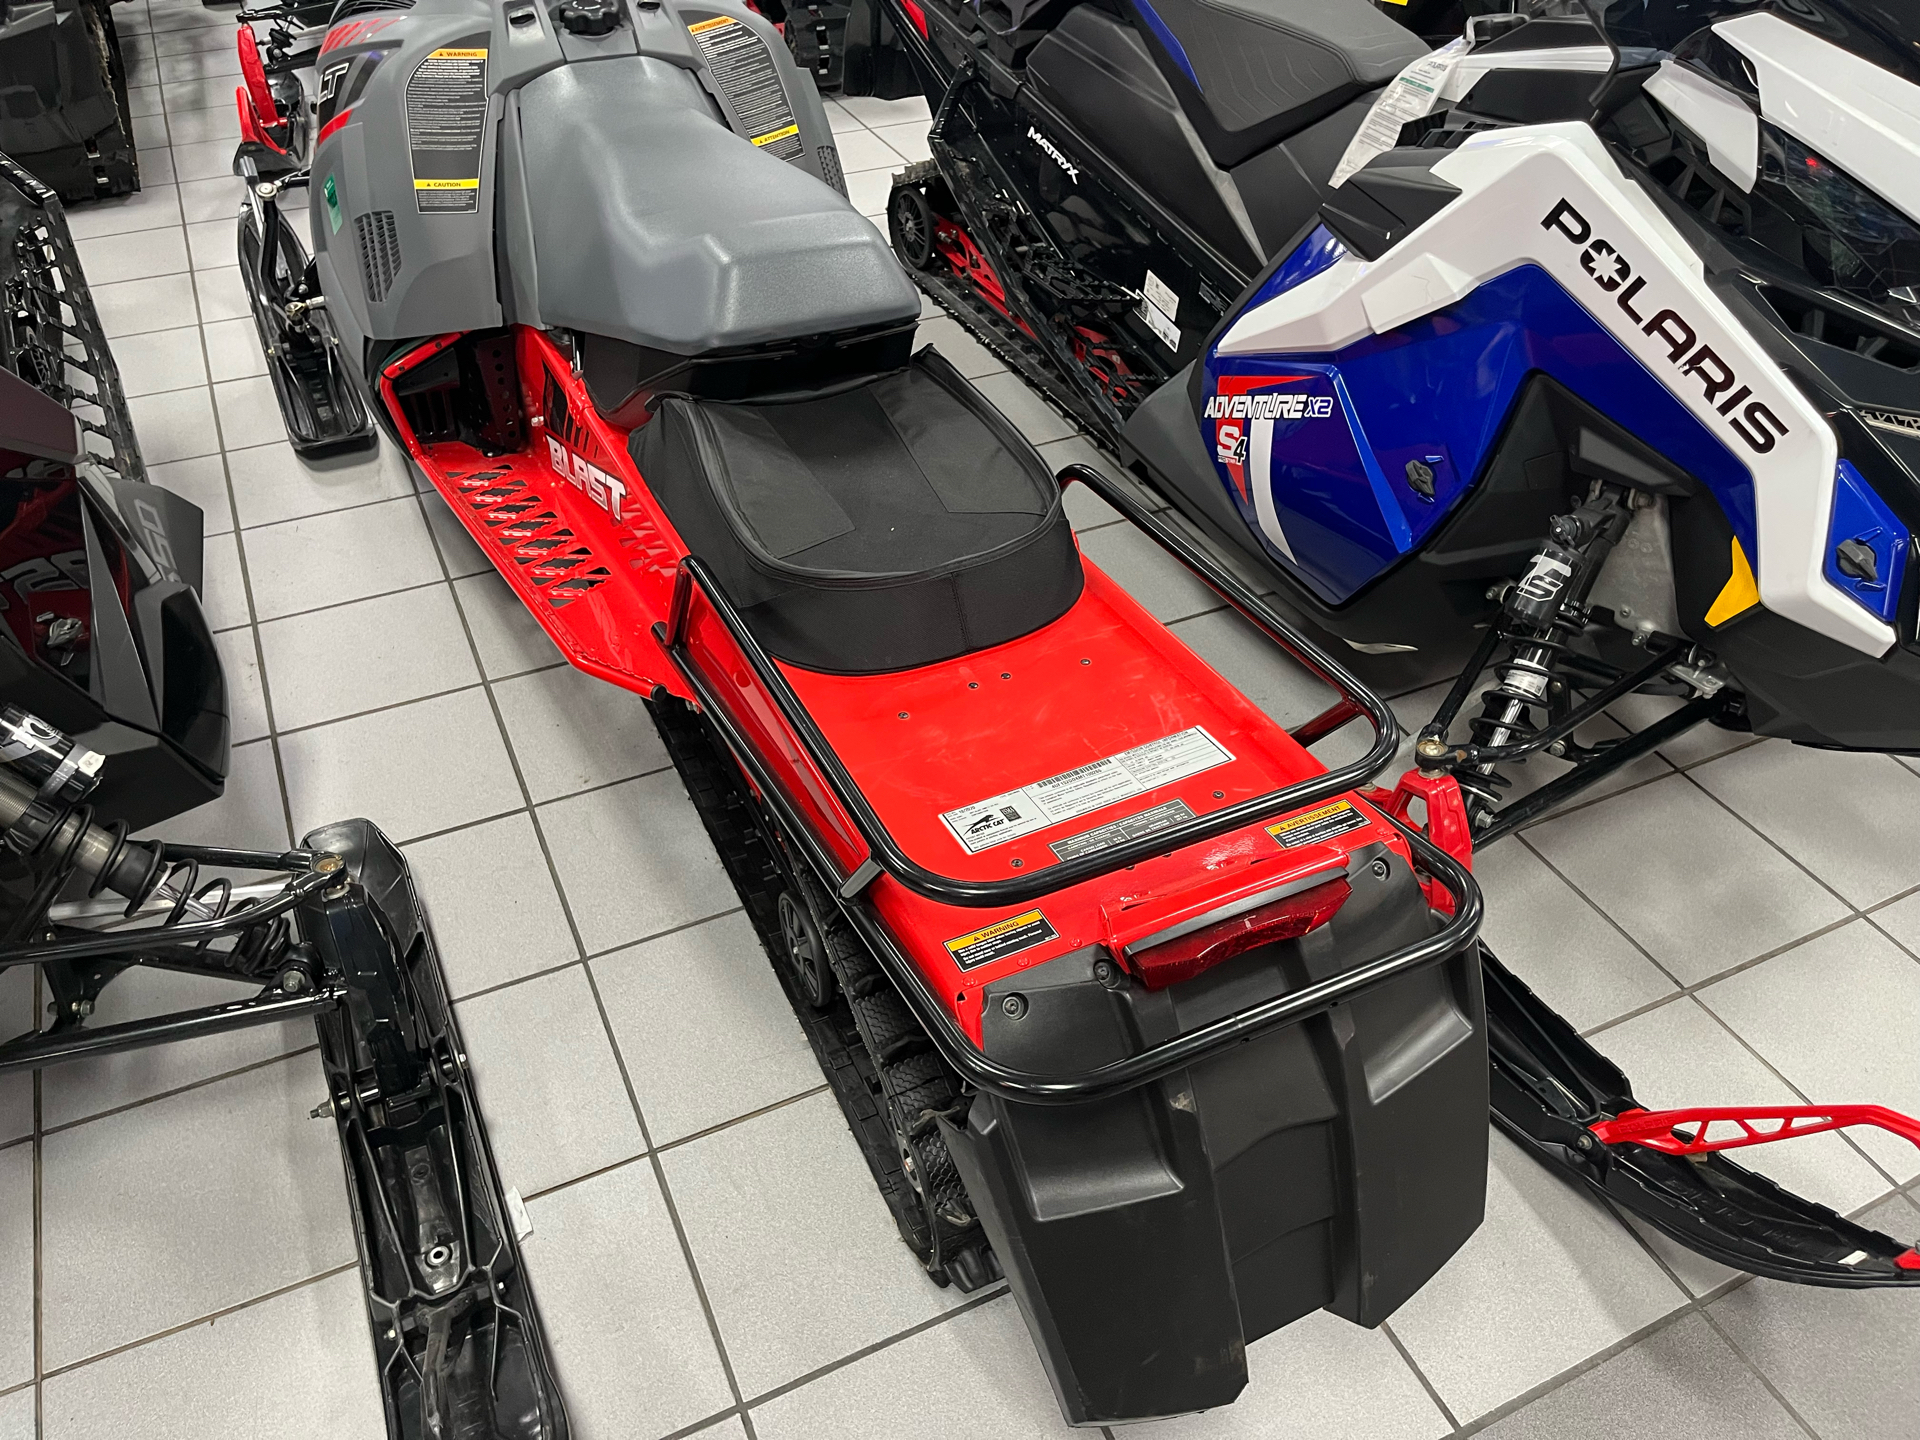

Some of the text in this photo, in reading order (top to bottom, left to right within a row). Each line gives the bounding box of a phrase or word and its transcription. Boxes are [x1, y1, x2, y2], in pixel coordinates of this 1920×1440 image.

[1027, 126, 1079, 185] MATRYX
[1540, 197, 1790, 454] POLARIS
[1203, 393, 1333, 419] ADVENTURE X2
[545, 433, 626, 521] BLAST
[970, 818, 1005, 835] ARCTIC CAT
[980, 921, 1020, 938] WARNING
